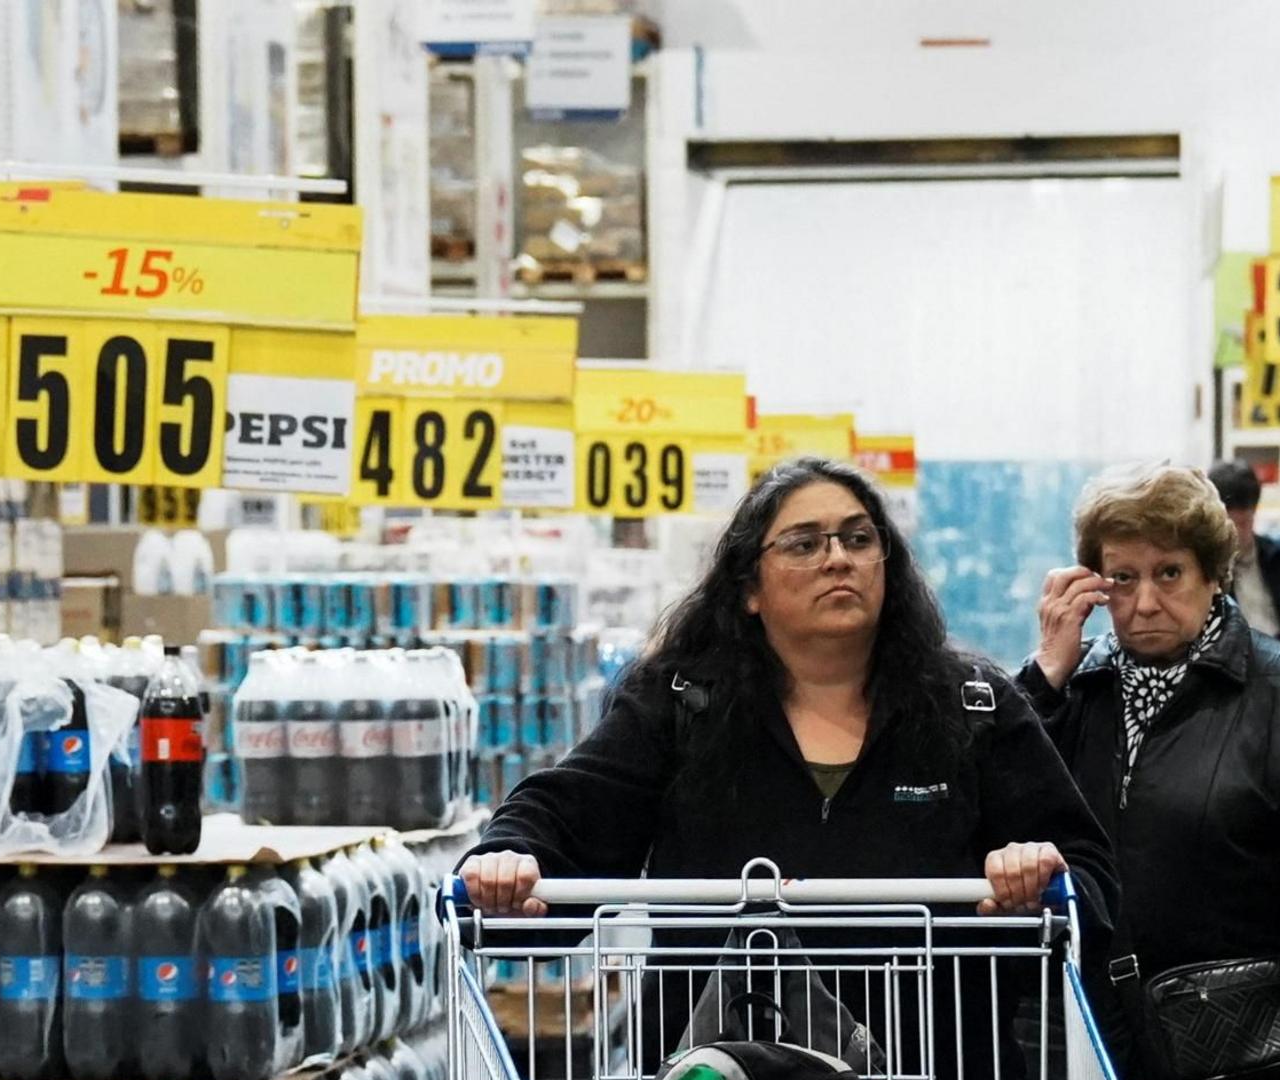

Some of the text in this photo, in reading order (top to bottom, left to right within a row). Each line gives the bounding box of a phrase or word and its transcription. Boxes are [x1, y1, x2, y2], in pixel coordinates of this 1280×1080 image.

[82, 248, 205, 298] -15%
[369, 350, 504, 387] PROMO
[360, 410, 495, 499] 482
[587, 442, 685, 510] 039
